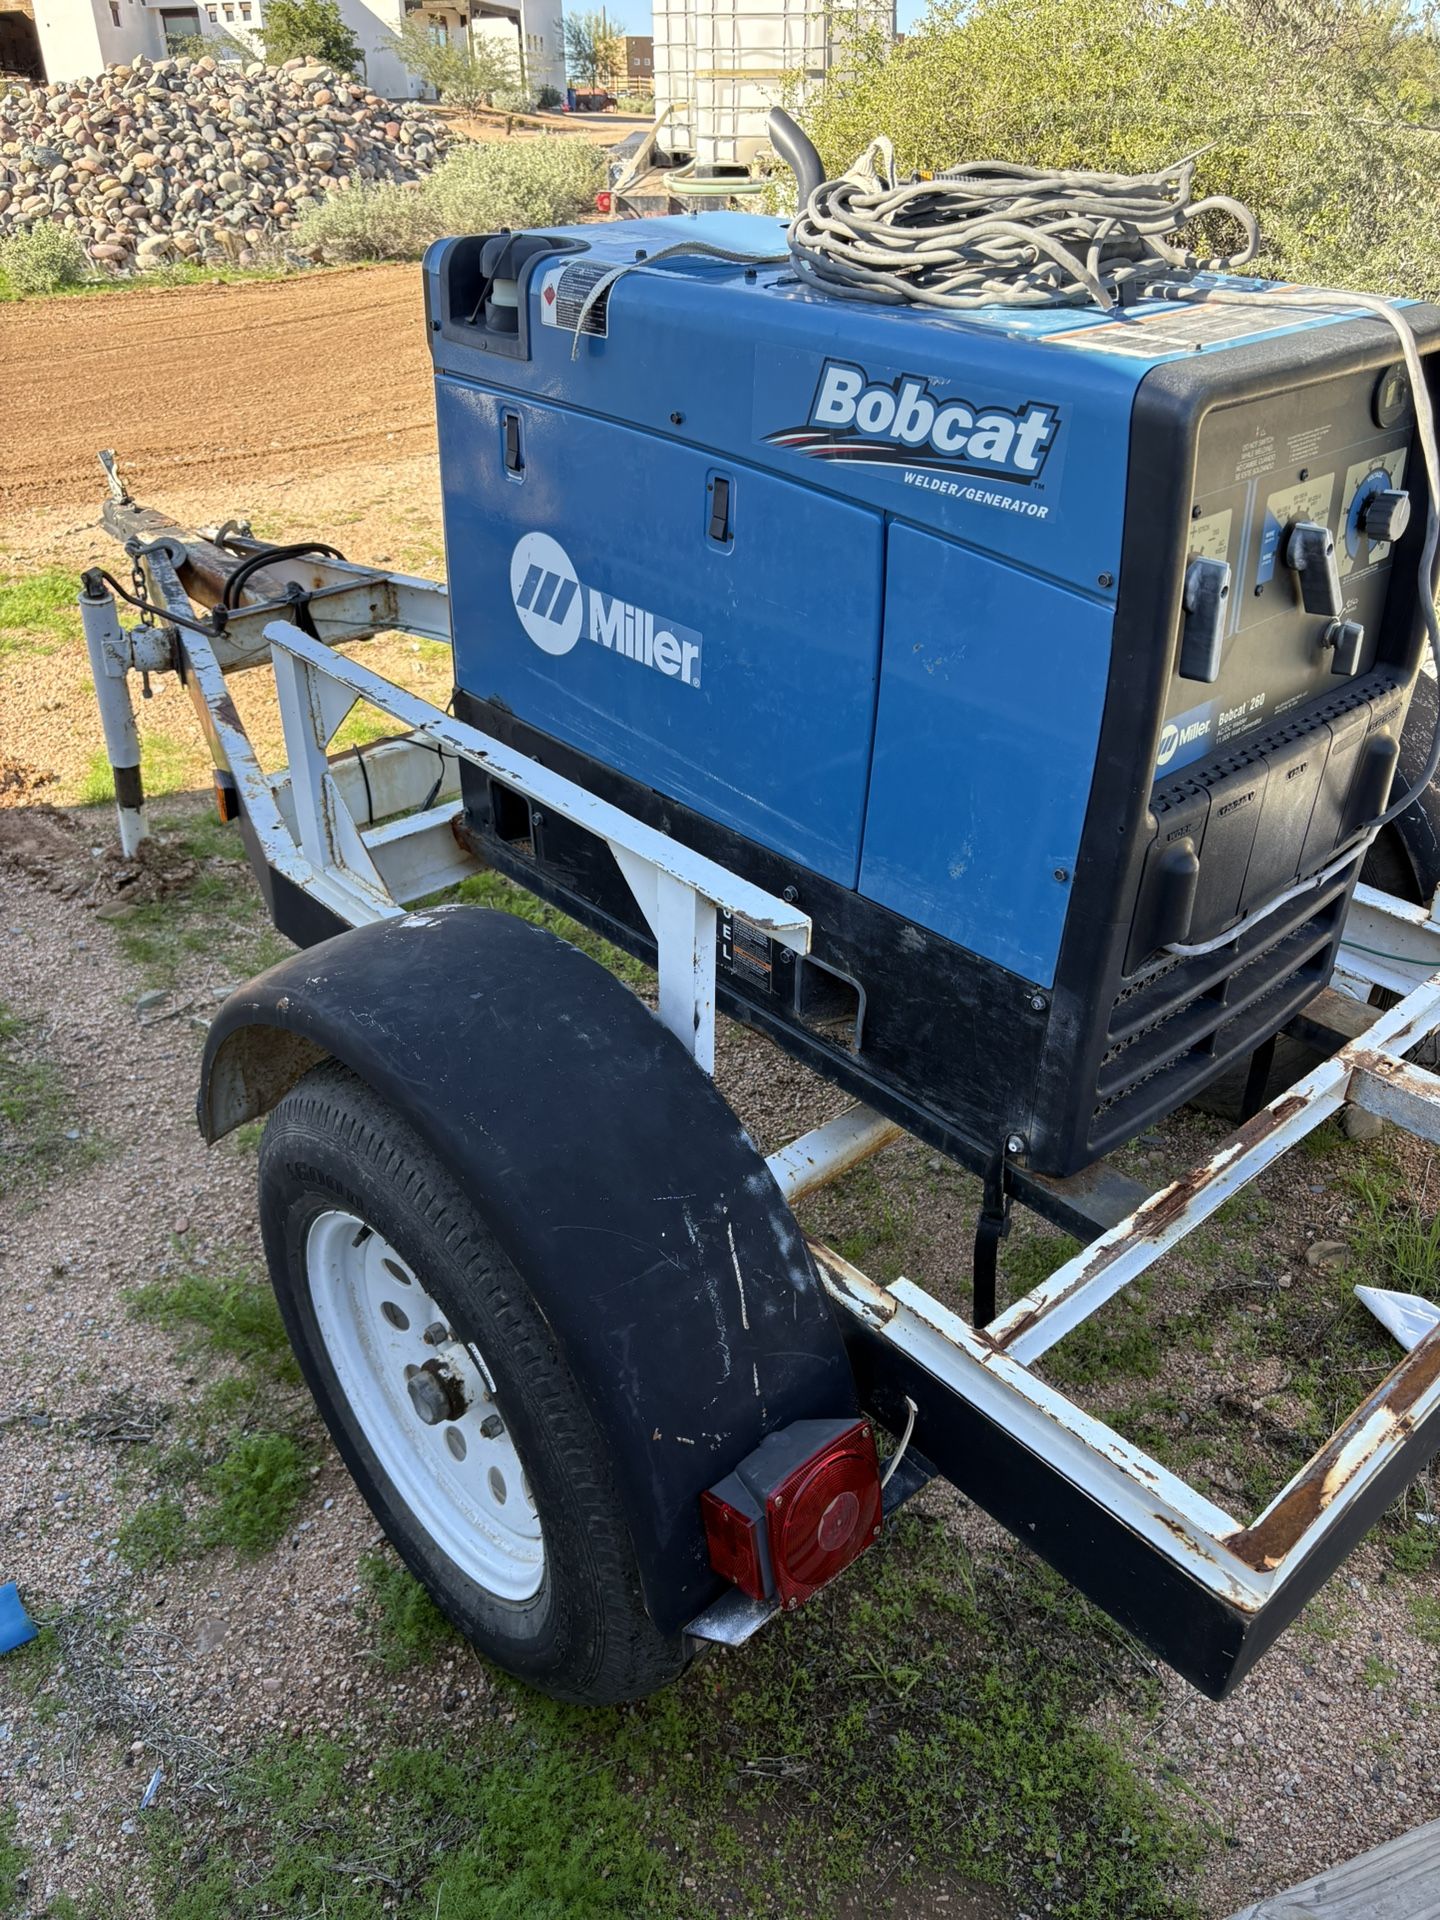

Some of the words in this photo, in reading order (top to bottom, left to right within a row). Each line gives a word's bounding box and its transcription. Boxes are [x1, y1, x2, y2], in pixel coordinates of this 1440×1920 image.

[815, 367, 1049, 471] Bobcat
[904, 472, 1049, 519] WELDER/GENERATOR
[589, 588, 699, 684] Miller
[1218, 702, 1246, 726] Bobcat
[1250, 692, 1266, 711] 260
[1179, 719, 1210, 747] Miller
